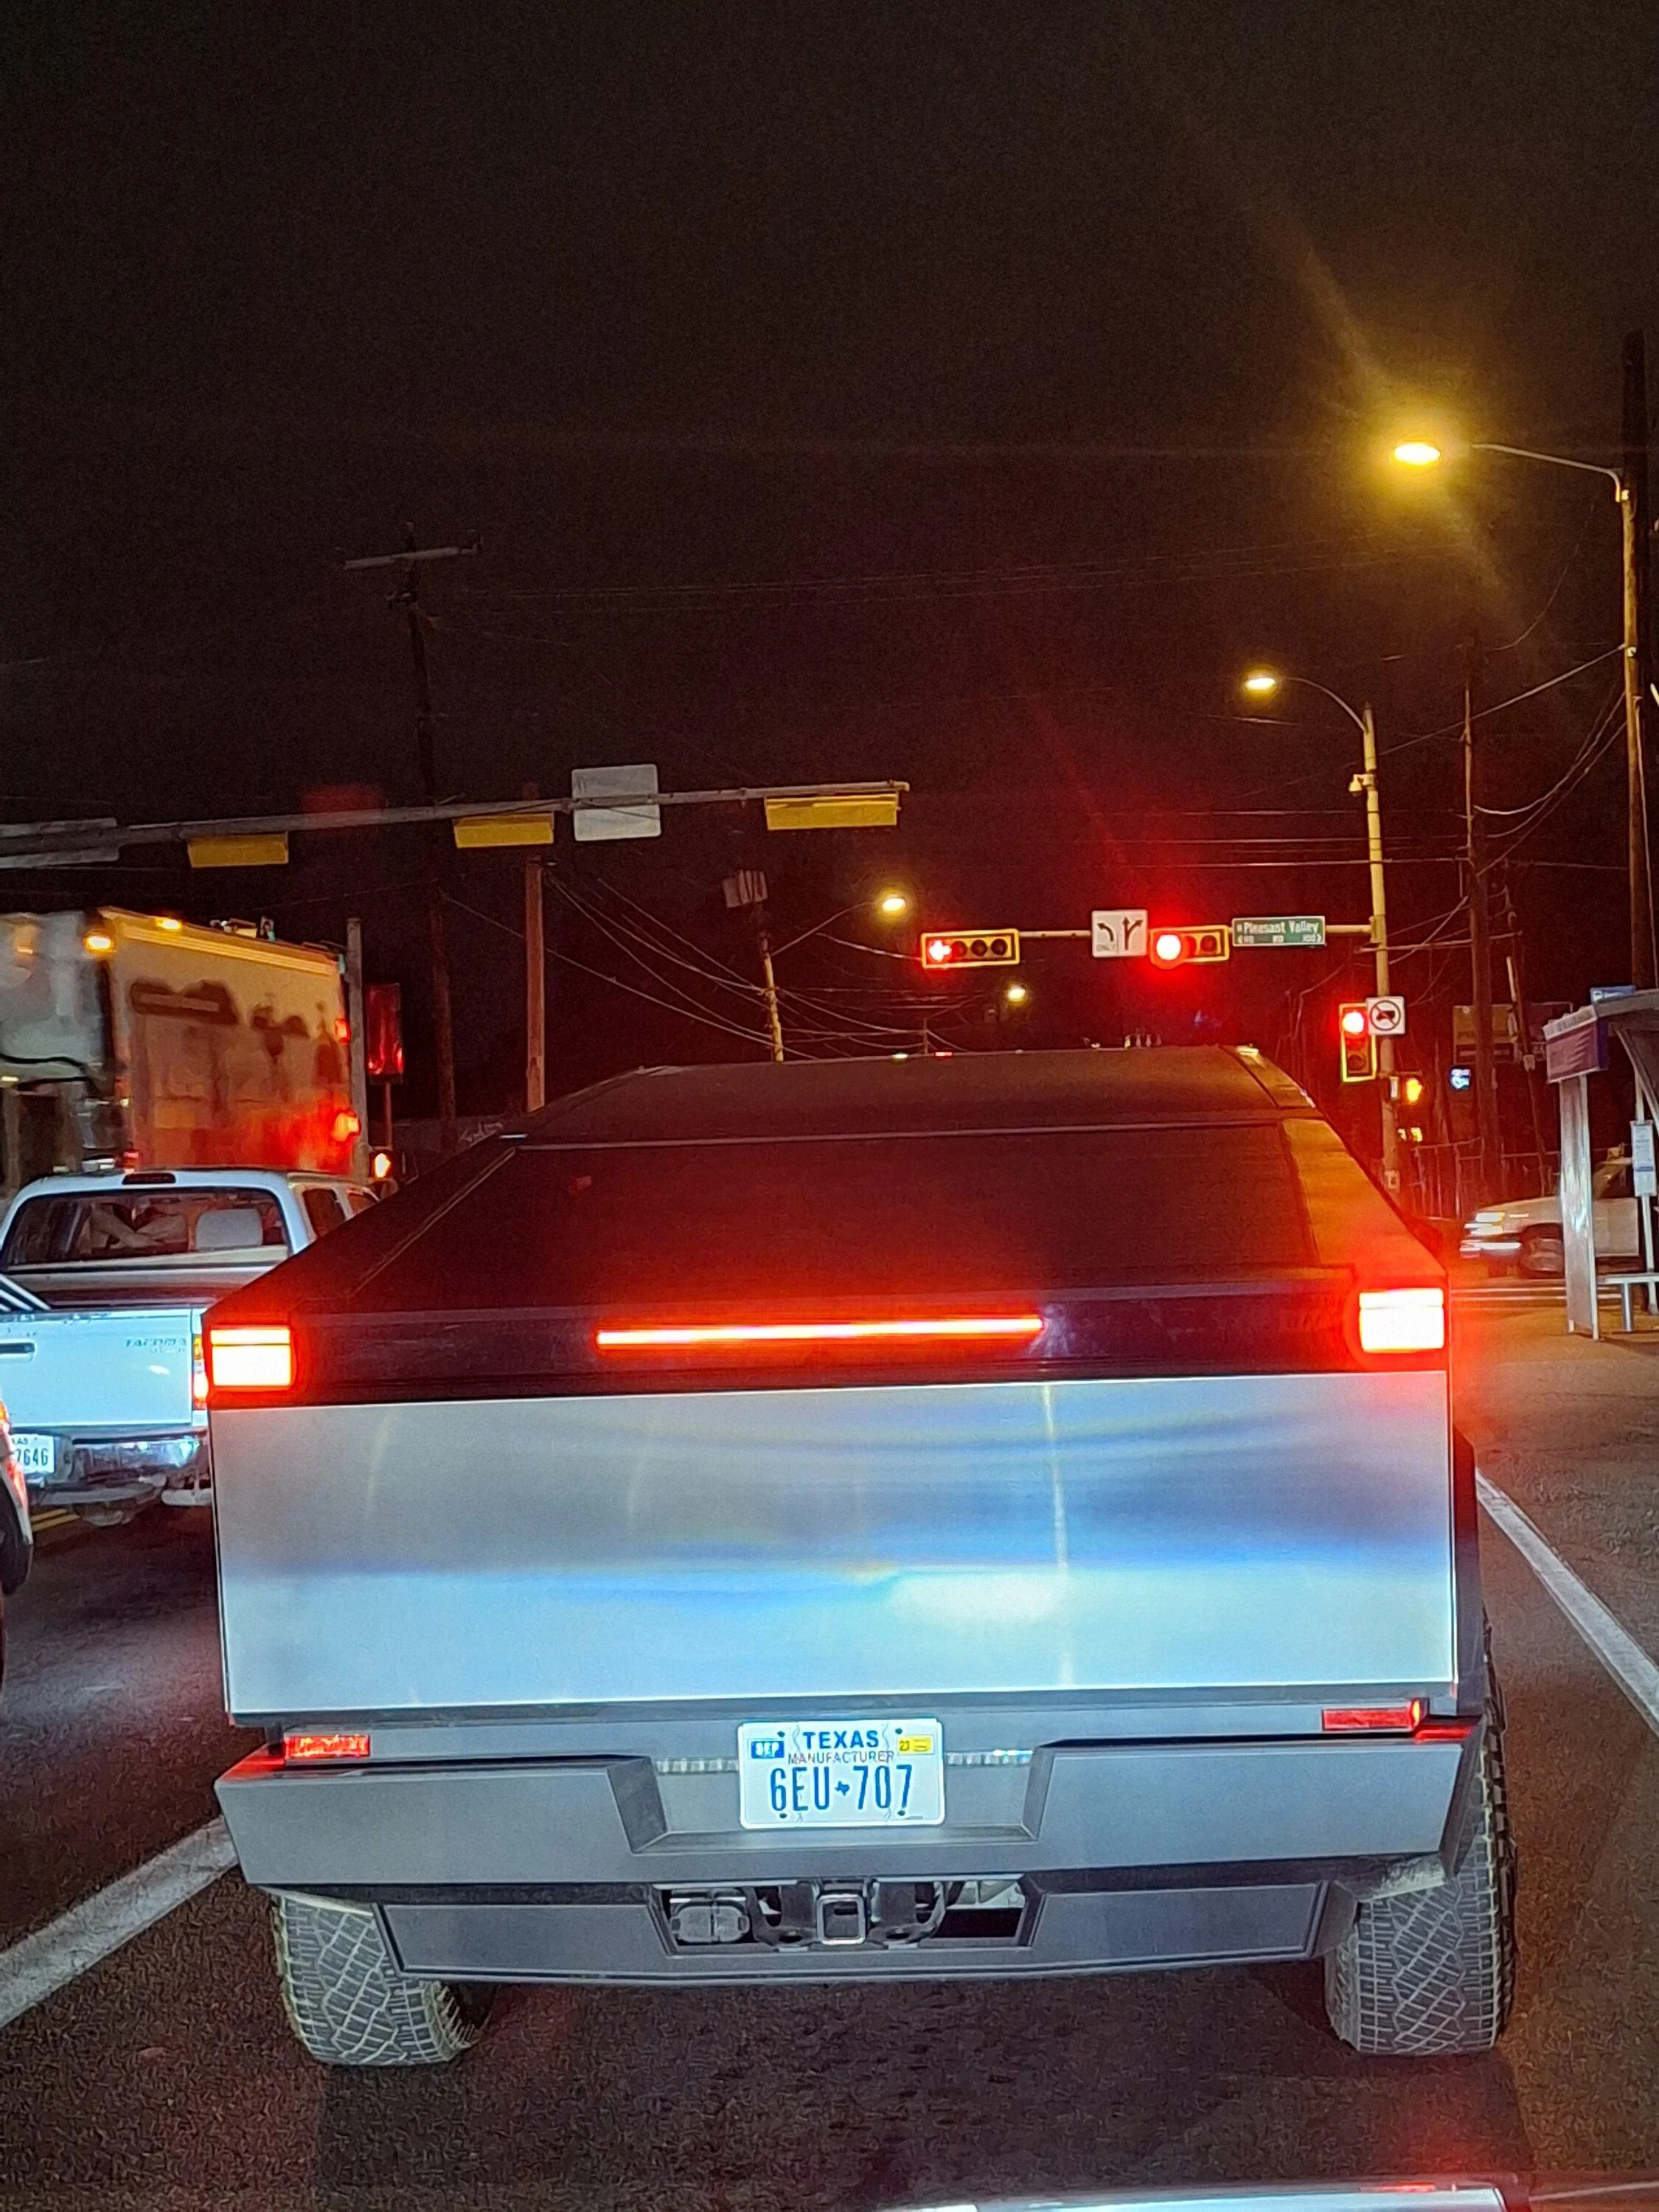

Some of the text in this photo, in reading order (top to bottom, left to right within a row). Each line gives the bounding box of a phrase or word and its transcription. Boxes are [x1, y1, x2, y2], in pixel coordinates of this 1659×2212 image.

[1243, 922, 1286, 934] Pleasant
[1288, 920, 1319, 933] Valley
[802, 1730, 879, 1749] TEXAS
[755, 1741, 780, 1758] SEP
[788, 1750, 894, 1764] MANUFACTURER
[770, 1764, 913, 1812] 6EU 707
